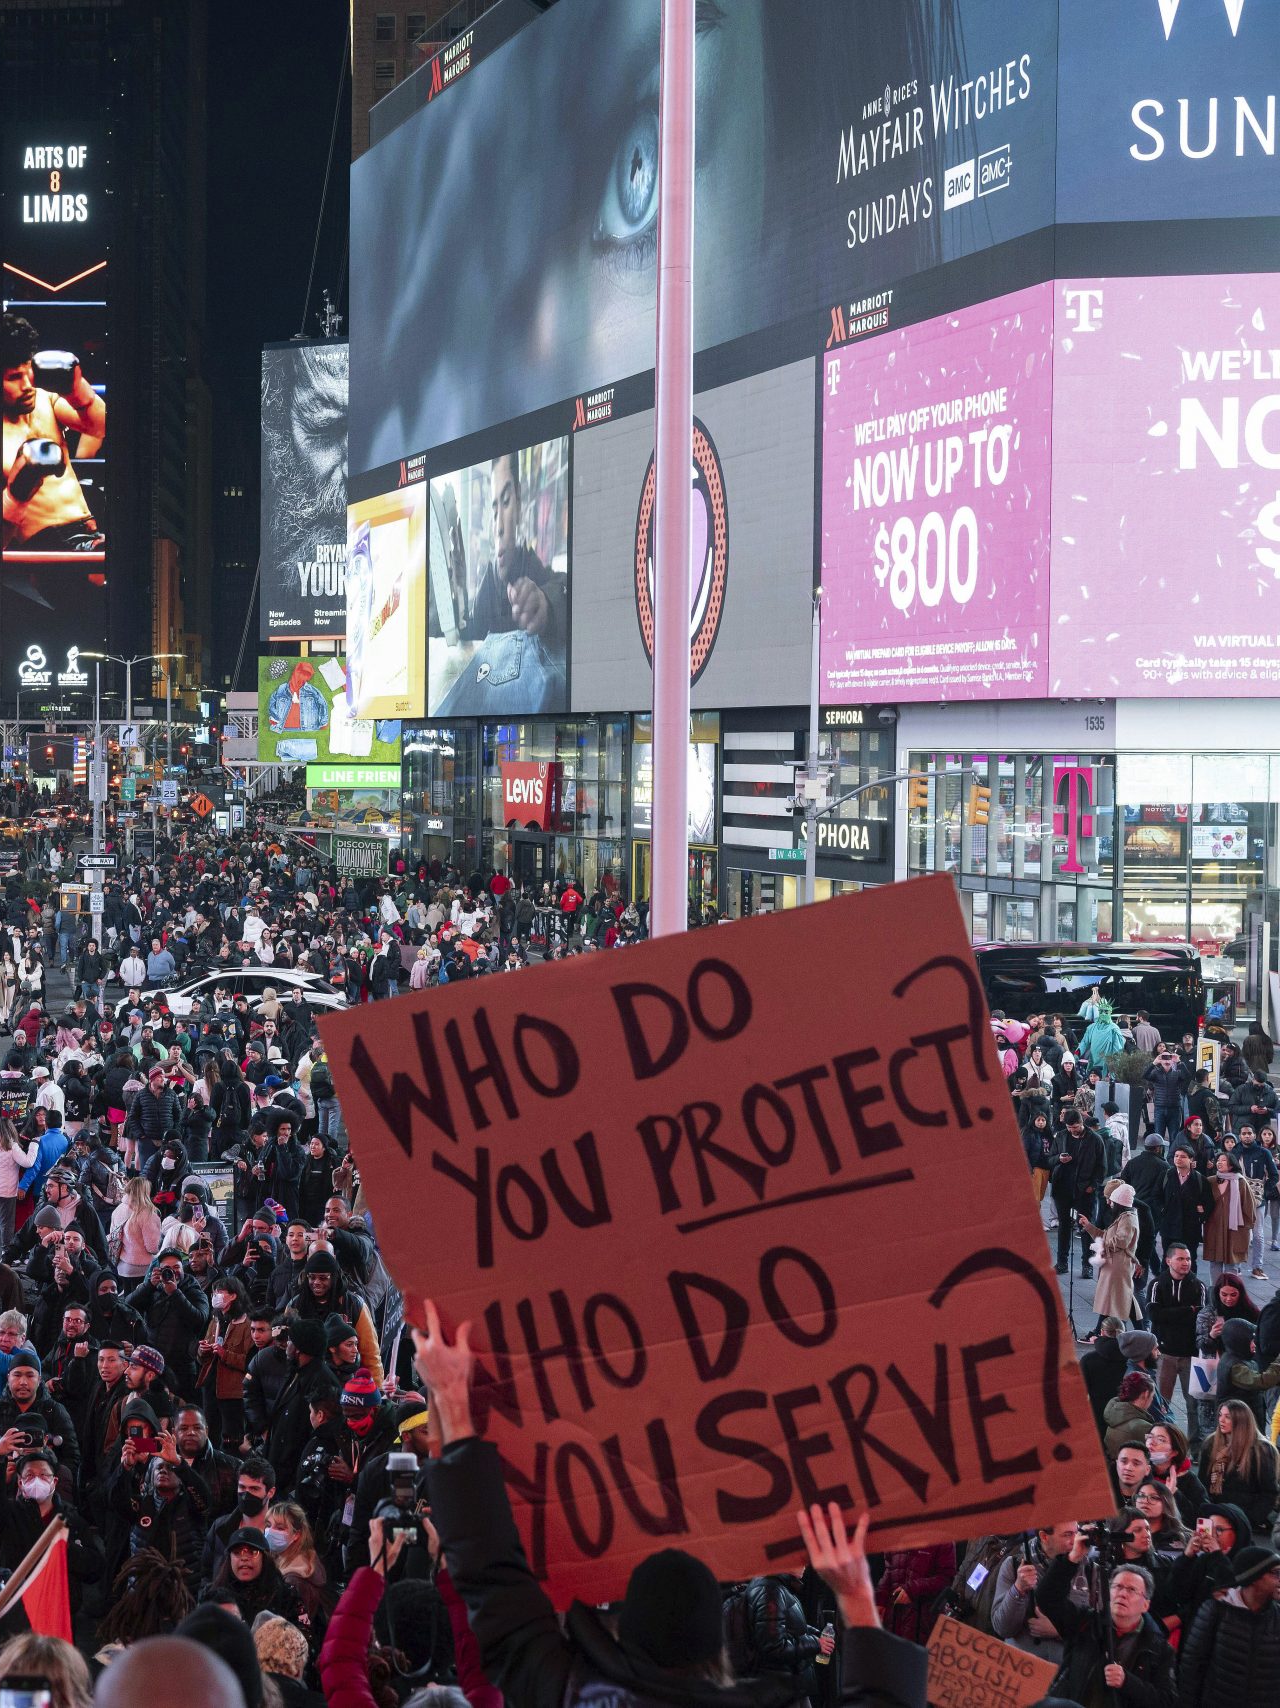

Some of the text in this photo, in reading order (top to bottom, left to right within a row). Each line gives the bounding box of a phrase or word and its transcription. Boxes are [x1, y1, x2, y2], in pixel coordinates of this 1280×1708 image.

[444, 30, 474, 64] MARRIOTT
[444, 52, 470, 84] MARQUIS
[862, 79, 918, 120] ANNE RICE'S
[836, 54, 1031, 184] MAYFAIR WITCHES
[24, 146, 87, 168] ARTS OF
[50, 170, 60, 192] 8
[23, 194, 88, 222] LIMBS
[846, 177, 933, 249] SUNDAYS
[850, 290, 892, 316] MARRIOTT
[850, 309, 888, 336] MARQUIS
[588, 388, 614, 407] MARRIOTT
[587, 404, 612, 422] MARQUIS
[855, 388, 1007, 446] WE'LL PAY OFF YOUR PHONE
[853, 425, 1011, 510] NOW UP TO
[875, 506, 978, 610] $800
[270, 610, 284, 618] New
[270, 618, 330, 628] Episodes Now
[1194, 636, 1274, 647] VIA VIRTUAL
[1191, 670, 1248, 680] with device
[826, 710, 862, 724] SEPHORA
[1084, 716, 1104, 730] 1535
[322, 771, 354, 782] LINE
[164, 790, 176, 798] 25
[337, 840, 382, 849] DISCOVER
[336, 848, 382, 867] BROADWAY'S
[336, 868, 382, 877] SECRETS
[349, 957, 753, 1158] WHO DO
[433, 955, 994, 1268] YOU PROTECT?
[471, 1246, 838, 1428] WHO DO
[506, 1247, 1073, 1582] YOU SERVE?
